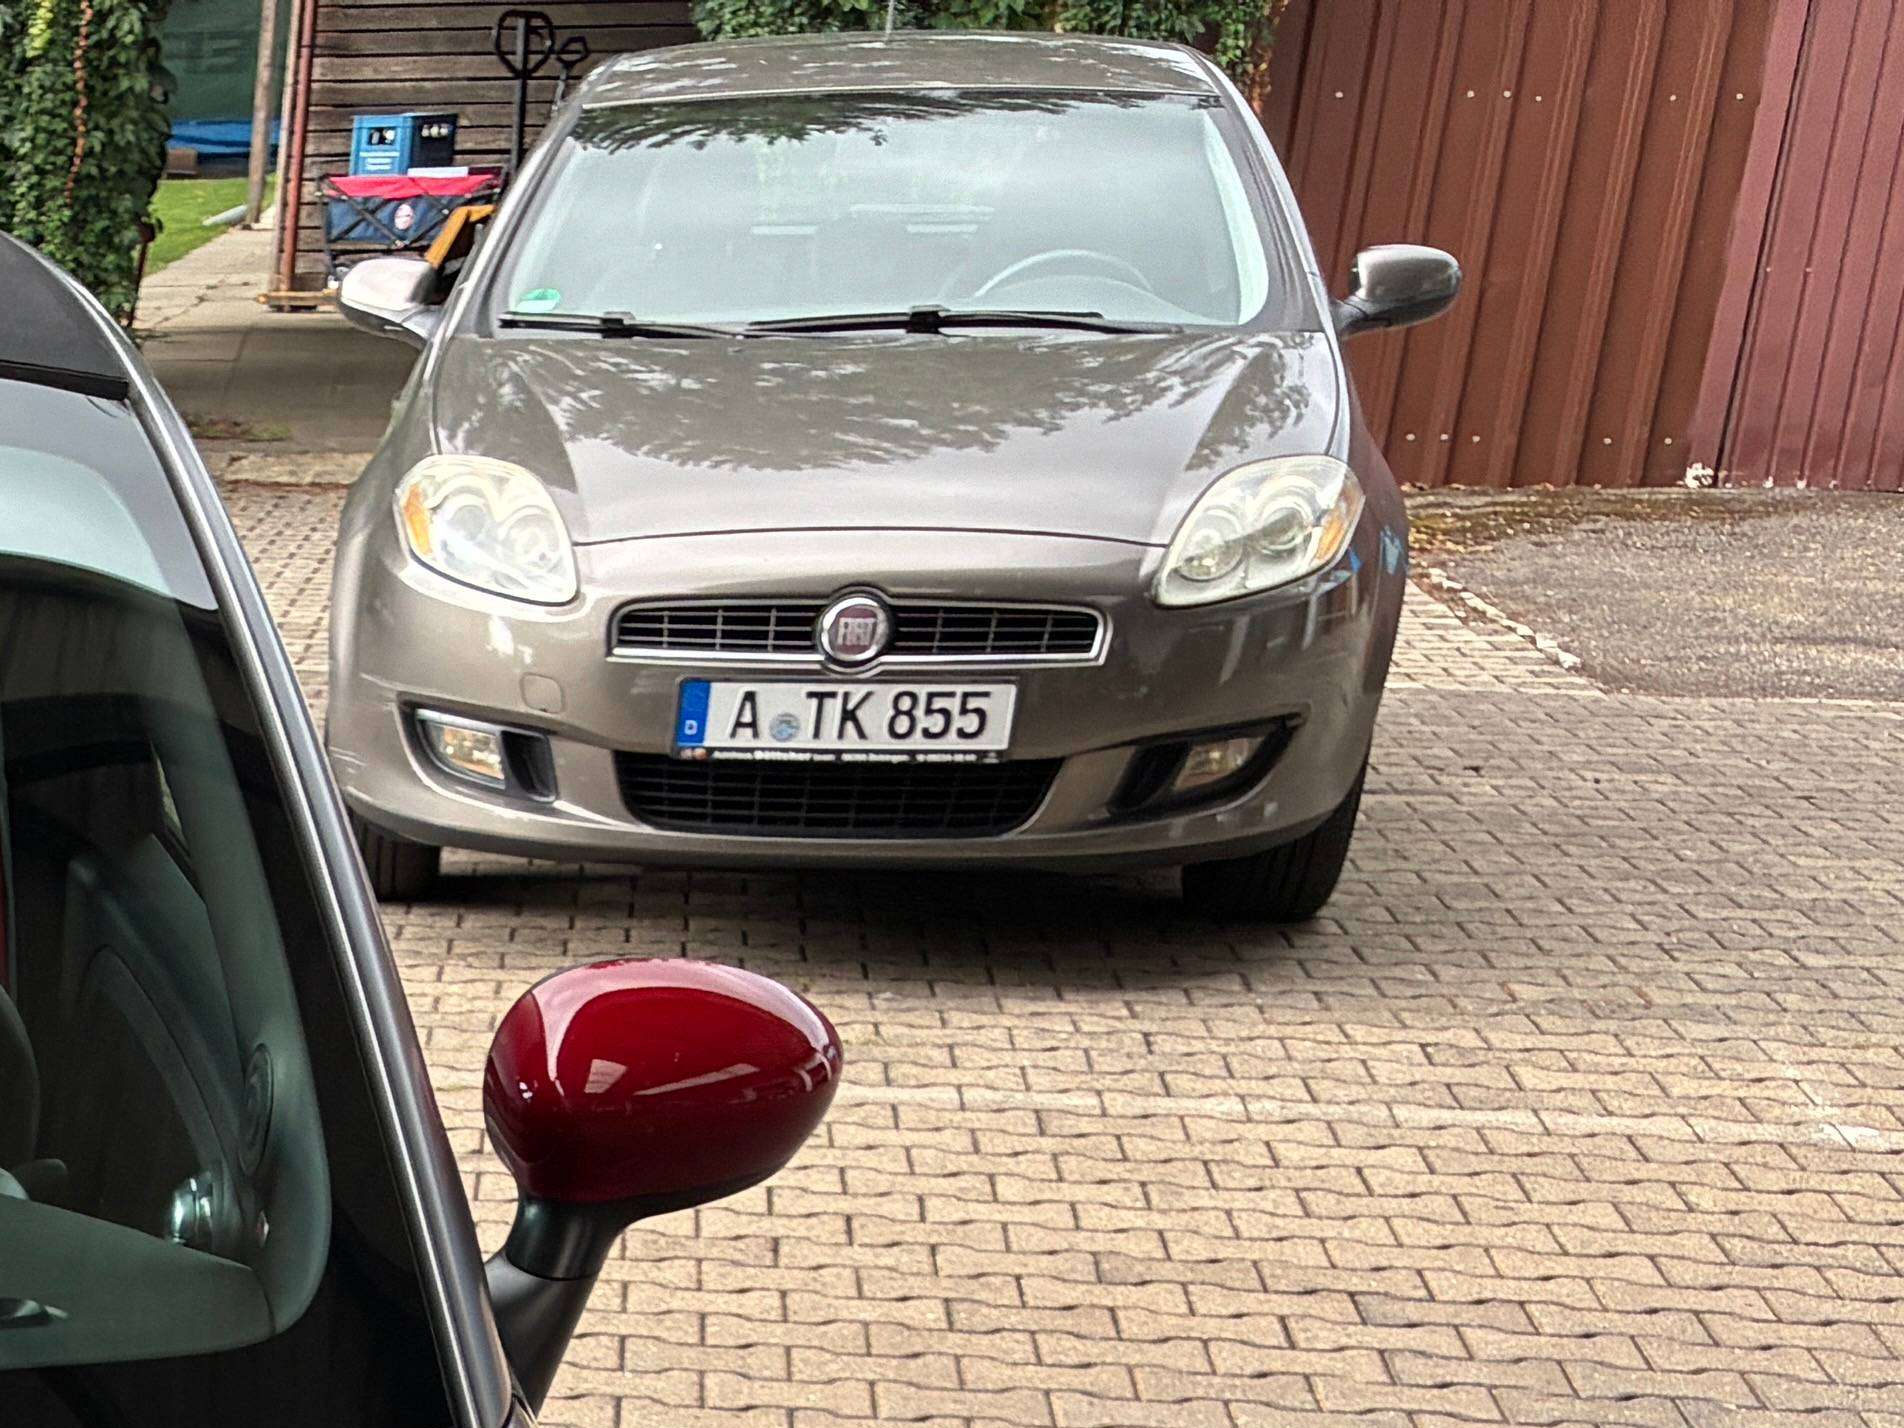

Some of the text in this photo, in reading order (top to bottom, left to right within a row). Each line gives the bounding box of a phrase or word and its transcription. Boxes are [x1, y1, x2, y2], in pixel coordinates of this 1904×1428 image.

[729, 690, 991, 740] A TK 855
